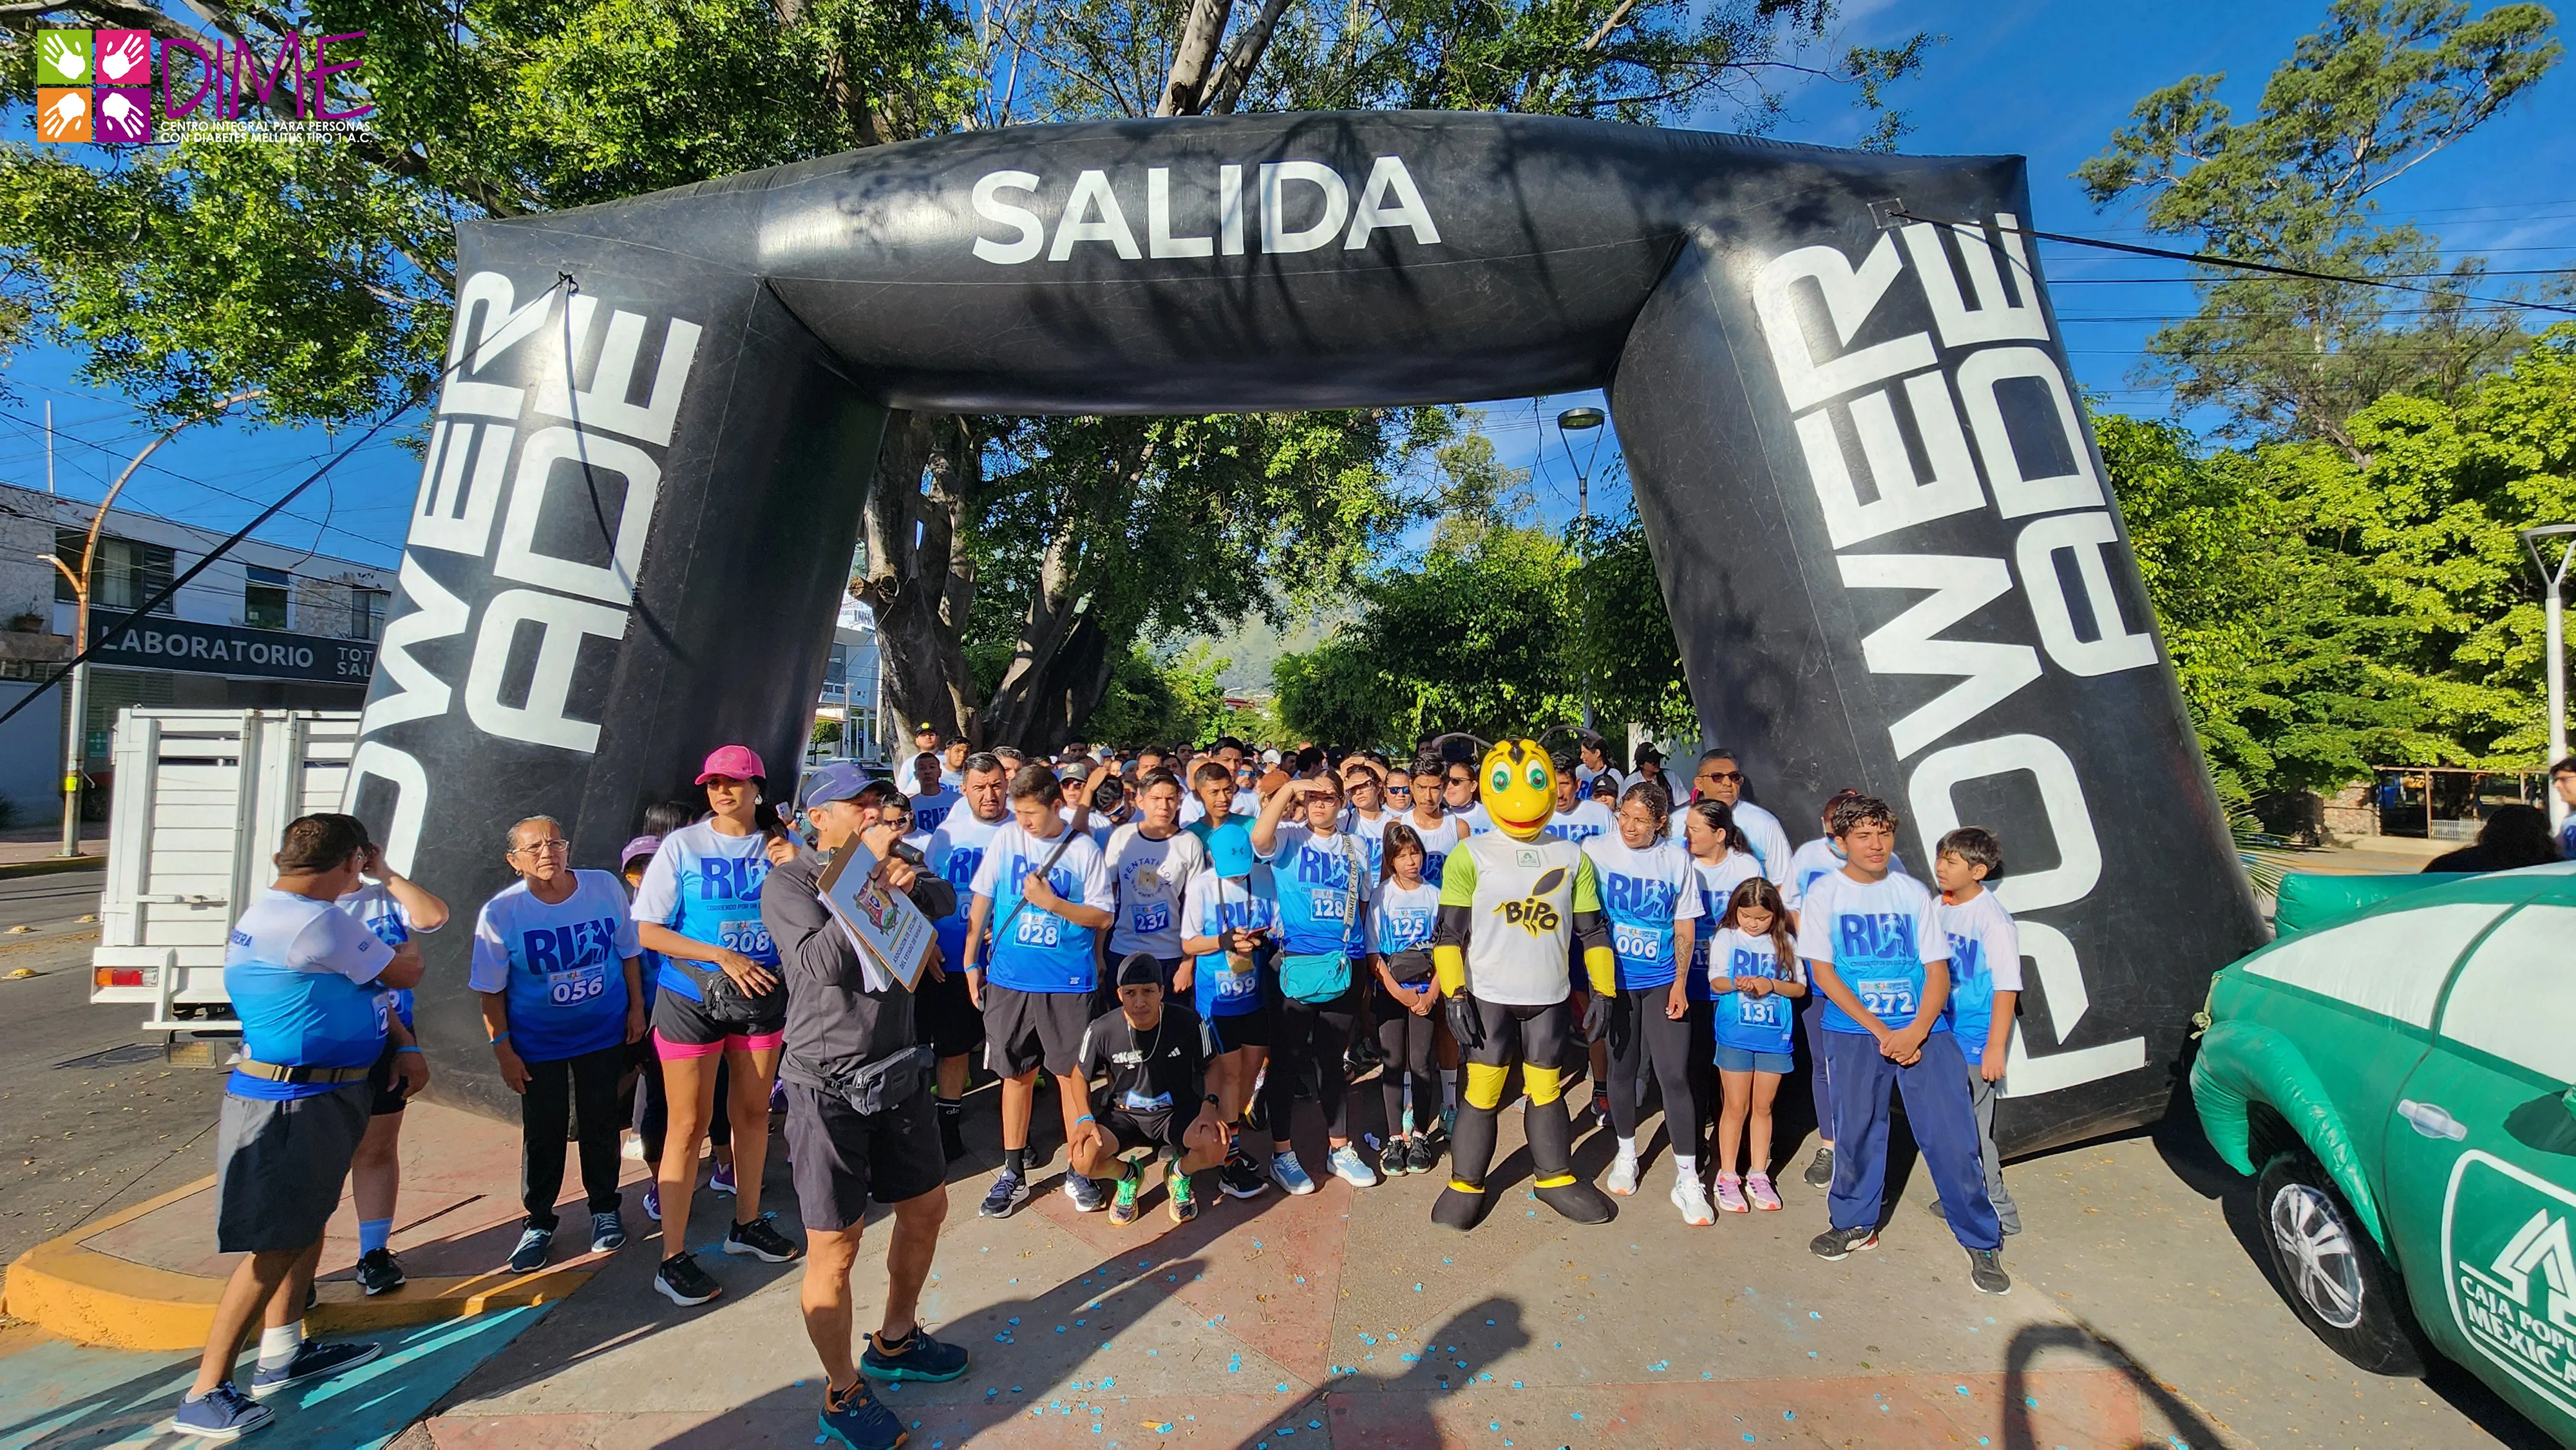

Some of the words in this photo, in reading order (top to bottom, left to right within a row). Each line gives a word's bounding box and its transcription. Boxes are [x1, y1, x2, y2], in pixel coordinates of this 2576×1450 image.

[971, 155, 1441, 265] SALIDA
[1904, 212, 2159, 677] ADE
[465, 296, 703, 754] ADE
[339, 271, 558, 880] OWER
[101, 626, 314, 667] LABORATORIO
[337, 647, 373, 663] TOT
[337, 661, 372, 677] SAL
[1753, 232, 2146, 1098] POWER
[1314, 899, 1345, 918] 128
[1607, 872, 1675, 919] RUN
[1018, 923, 1057, 946] 028
[1137, 910, 1167, 931] 237
[1392, 918, 1425, 936] 125
[1841, 914, 1916, 959] RUN
[523, 917, 616, 976] RUN
[723, 932, 771, 952] 208
[1616, 936, 1658, 959] 006
[553, 976, 603, 1002] 056
[1220, 977, 1256, 997] 099
[1864, 992, 1915, 1014] 272
[1742, 1002, 1776, 1023] 131
[2460, 1276, 2514, 1323] CAJA
[2519, 1309, 2576, 1361] POPU
[2465, 1297, 2576, 1385] MEXICA
